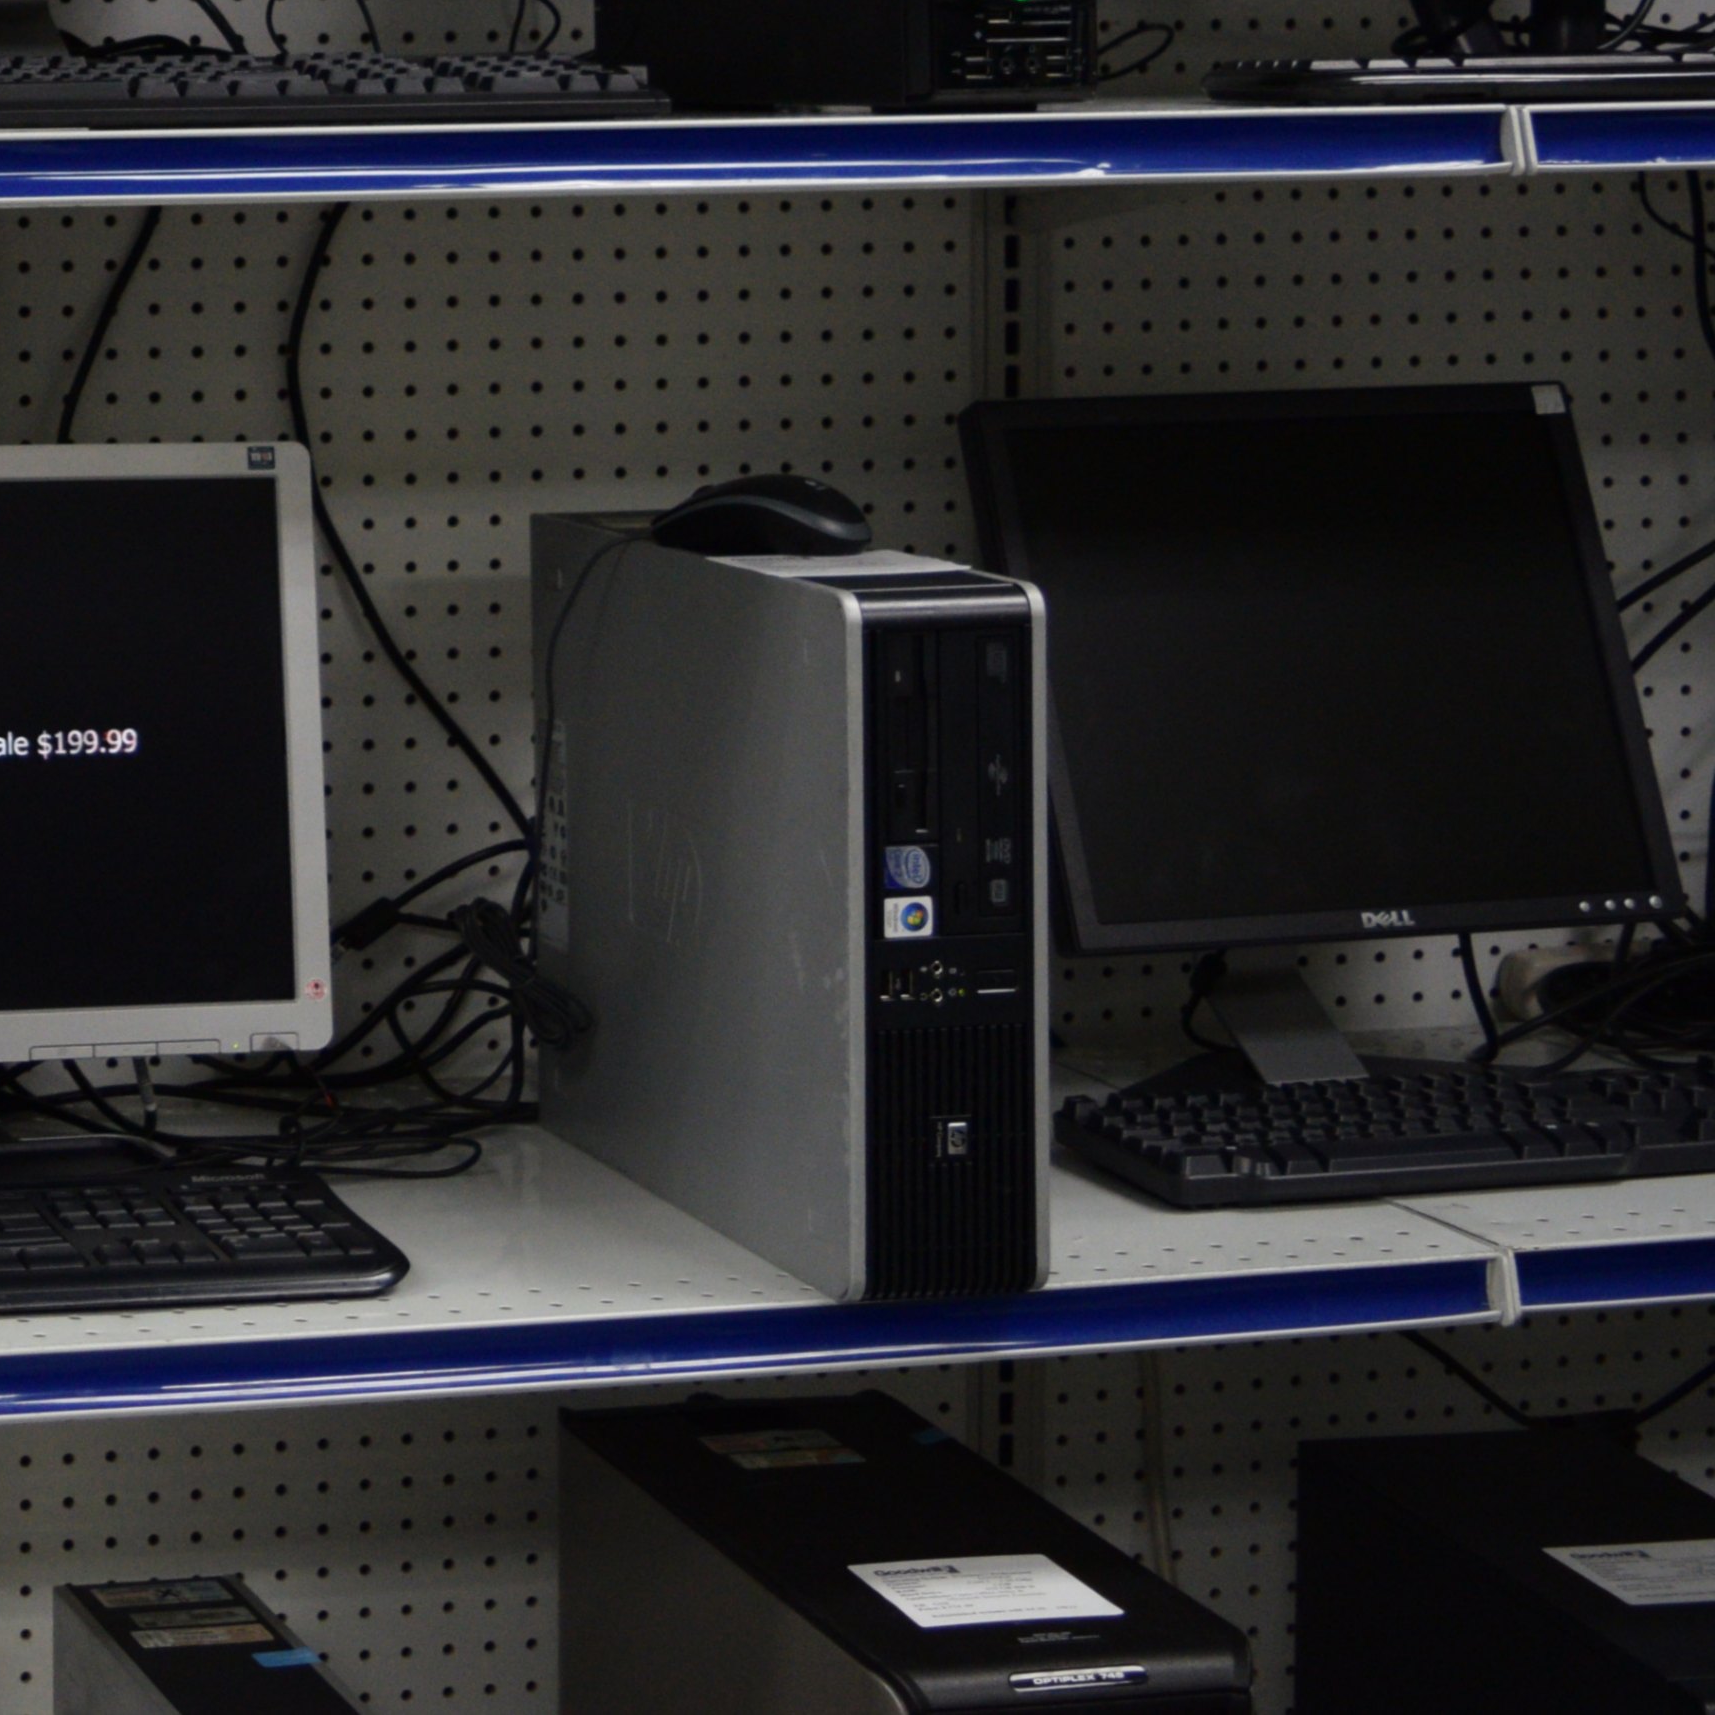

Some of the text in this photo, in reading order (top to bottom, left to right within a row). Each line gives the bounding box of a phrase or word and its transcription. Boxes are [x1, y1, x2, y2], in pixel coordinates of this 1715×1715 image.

[36, 727, 140, 761] $199.99
[1360, 908, 1416, 929] DELL
[1032, 1674, 1097, 1686] OPTIPLEX
